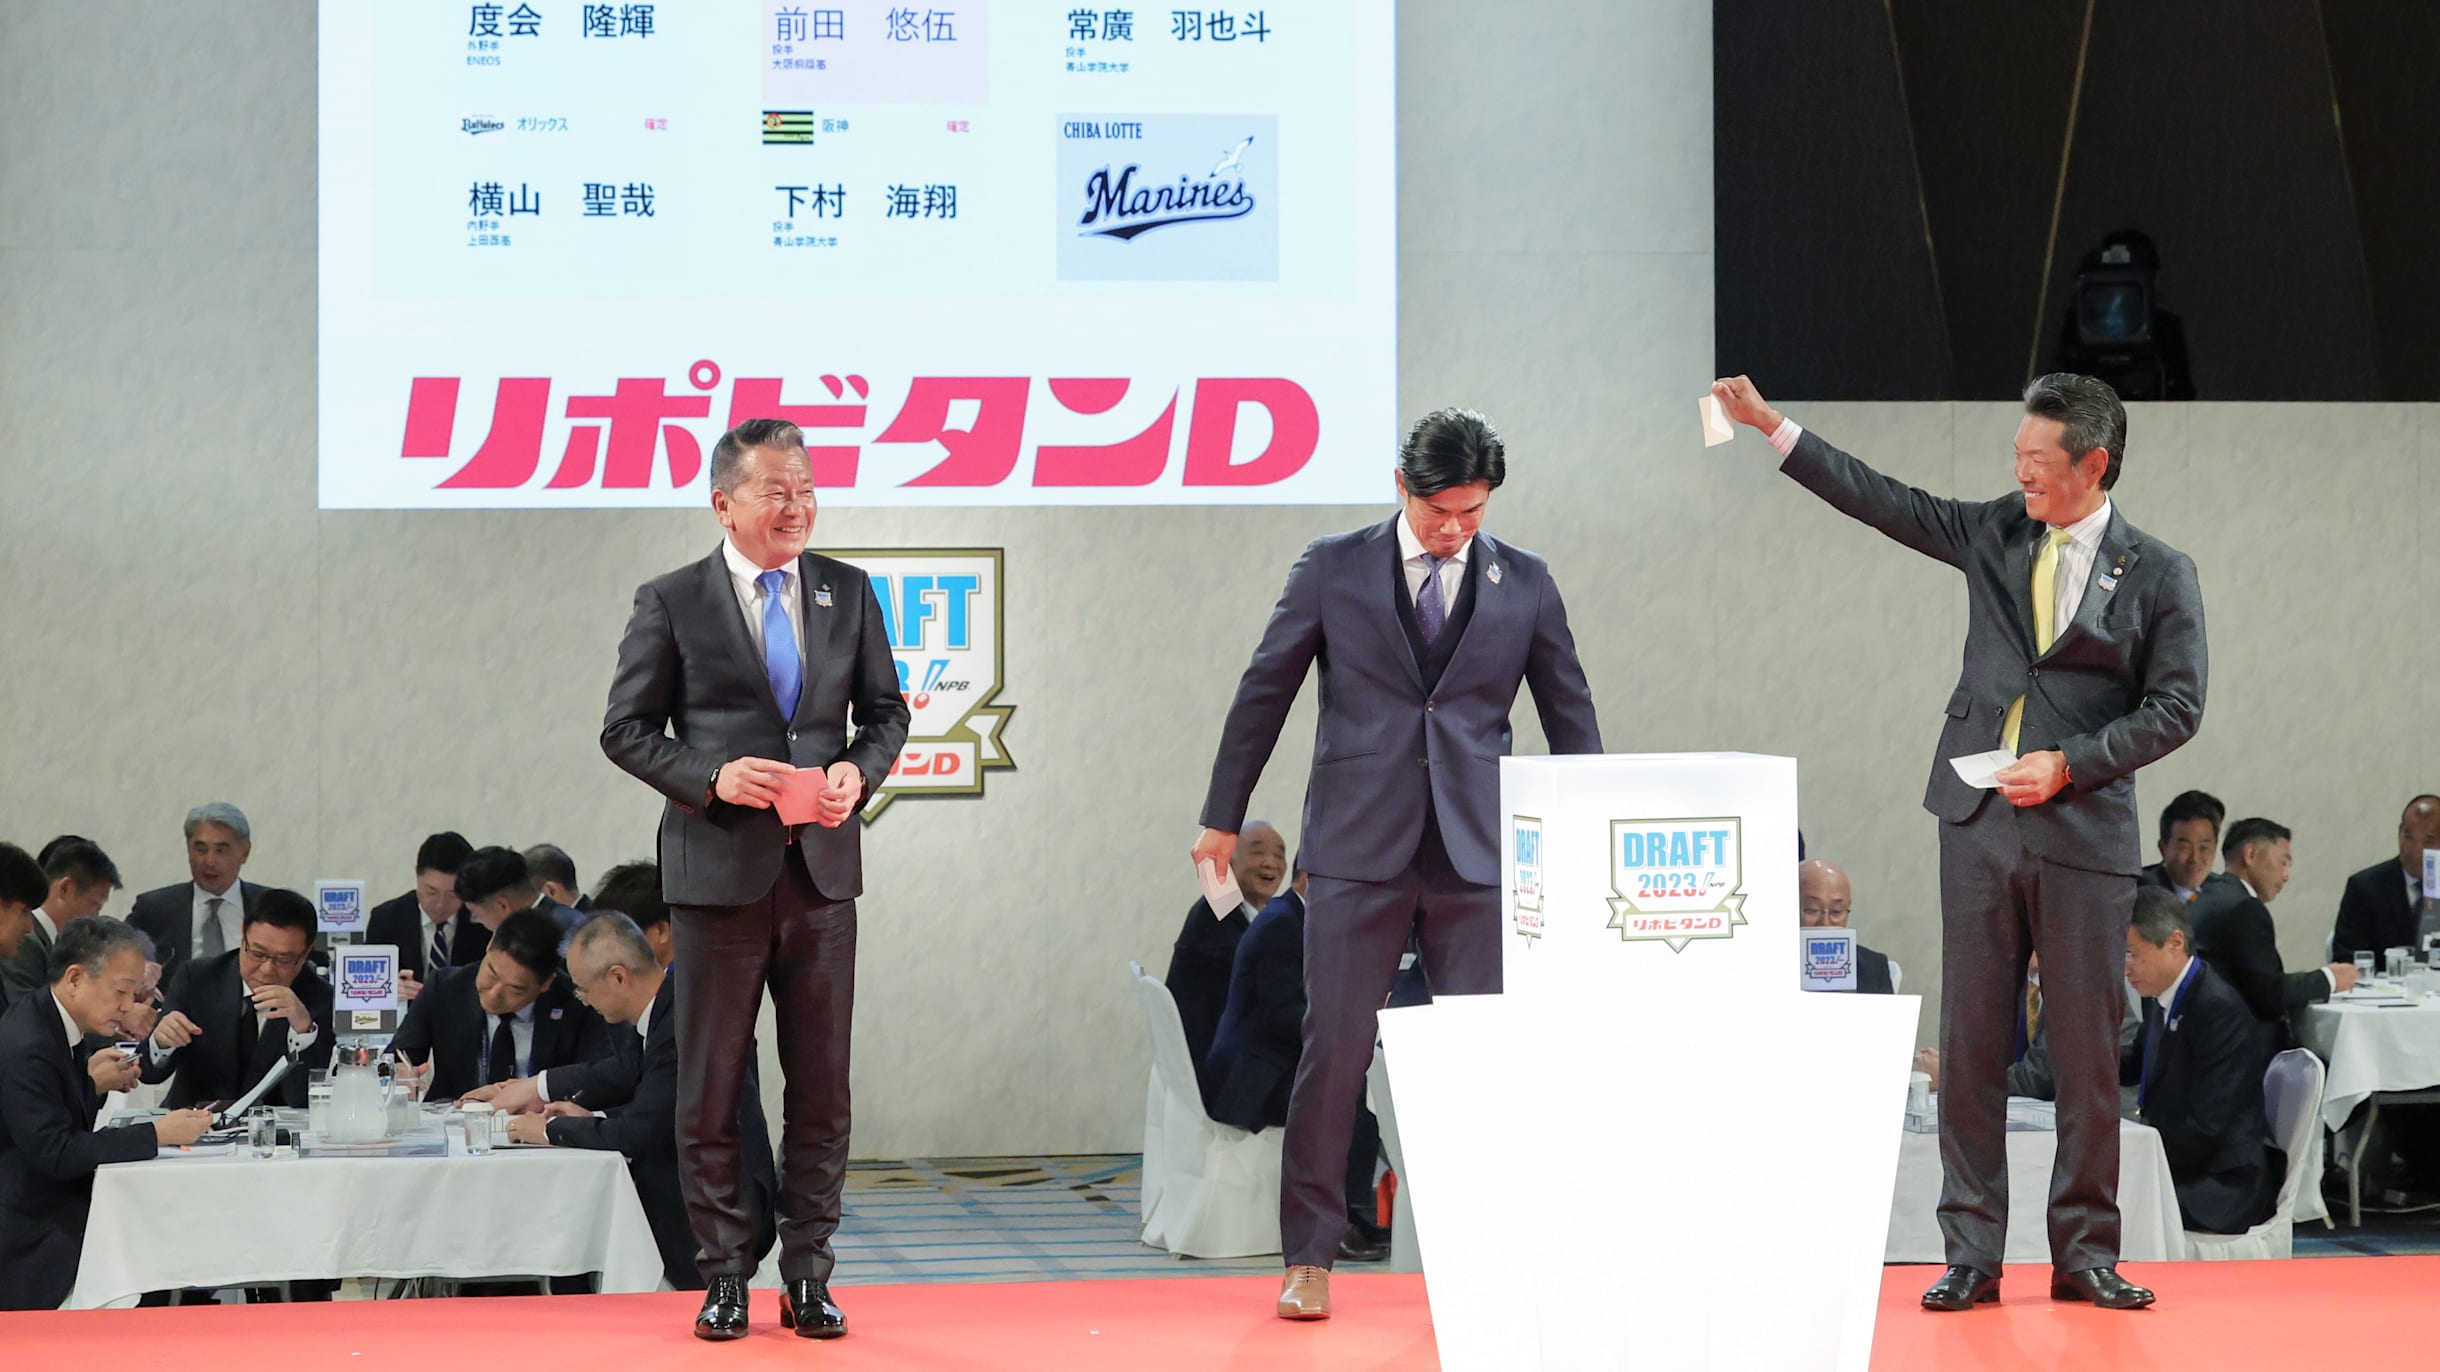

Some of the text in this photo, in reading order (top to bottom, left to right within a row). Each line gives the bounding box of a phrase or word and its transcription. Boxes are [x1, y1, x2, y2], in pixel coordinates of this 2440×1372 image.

[469, 3, 655, 38] 度会 隆輝
[775, 6, 957, 42] 前田 悠伍
[1067, 9, 1271, 43] 常廣 羽也斗
[467, 40, 500, 51] 外野手
[772, 44, 794, 55] 投手
[1065, 47, 1086, 58] 投手
[466, 56, 501, 66] ENEOS
[1065, 62, 1129, 73] 青山学院大学
[517, 117, 568, 131] オリックス
[822, 119, 849, 133] 阪神
[1064, 121, 1143, 139] CHIBA LOTTE
[469, 182, 655, 217] 横山 聖哉
[775, 184, 957, 219] 下村 海翔
[1077, 164, 1251, 228] Marines
[467, 220, 500, 232] 内野手
[773, 222, 794, 233] 投手
[773, 236, 838, 248] 青山学院大学
[400, 359, 1321, 489] リポビタンD
[934, 681, 970, 691] NPB
[1516, 828, 1539, 865] DRAFT
[1622, 830, 1730, 869] DRAFT
[324, 892, 355, 902] DRAFT
[1632, 917, 1722, 931] リポビタンD
[1811, 942, 1845, 954] DRAFT
[348, 960, 387, 973] DRAFT
